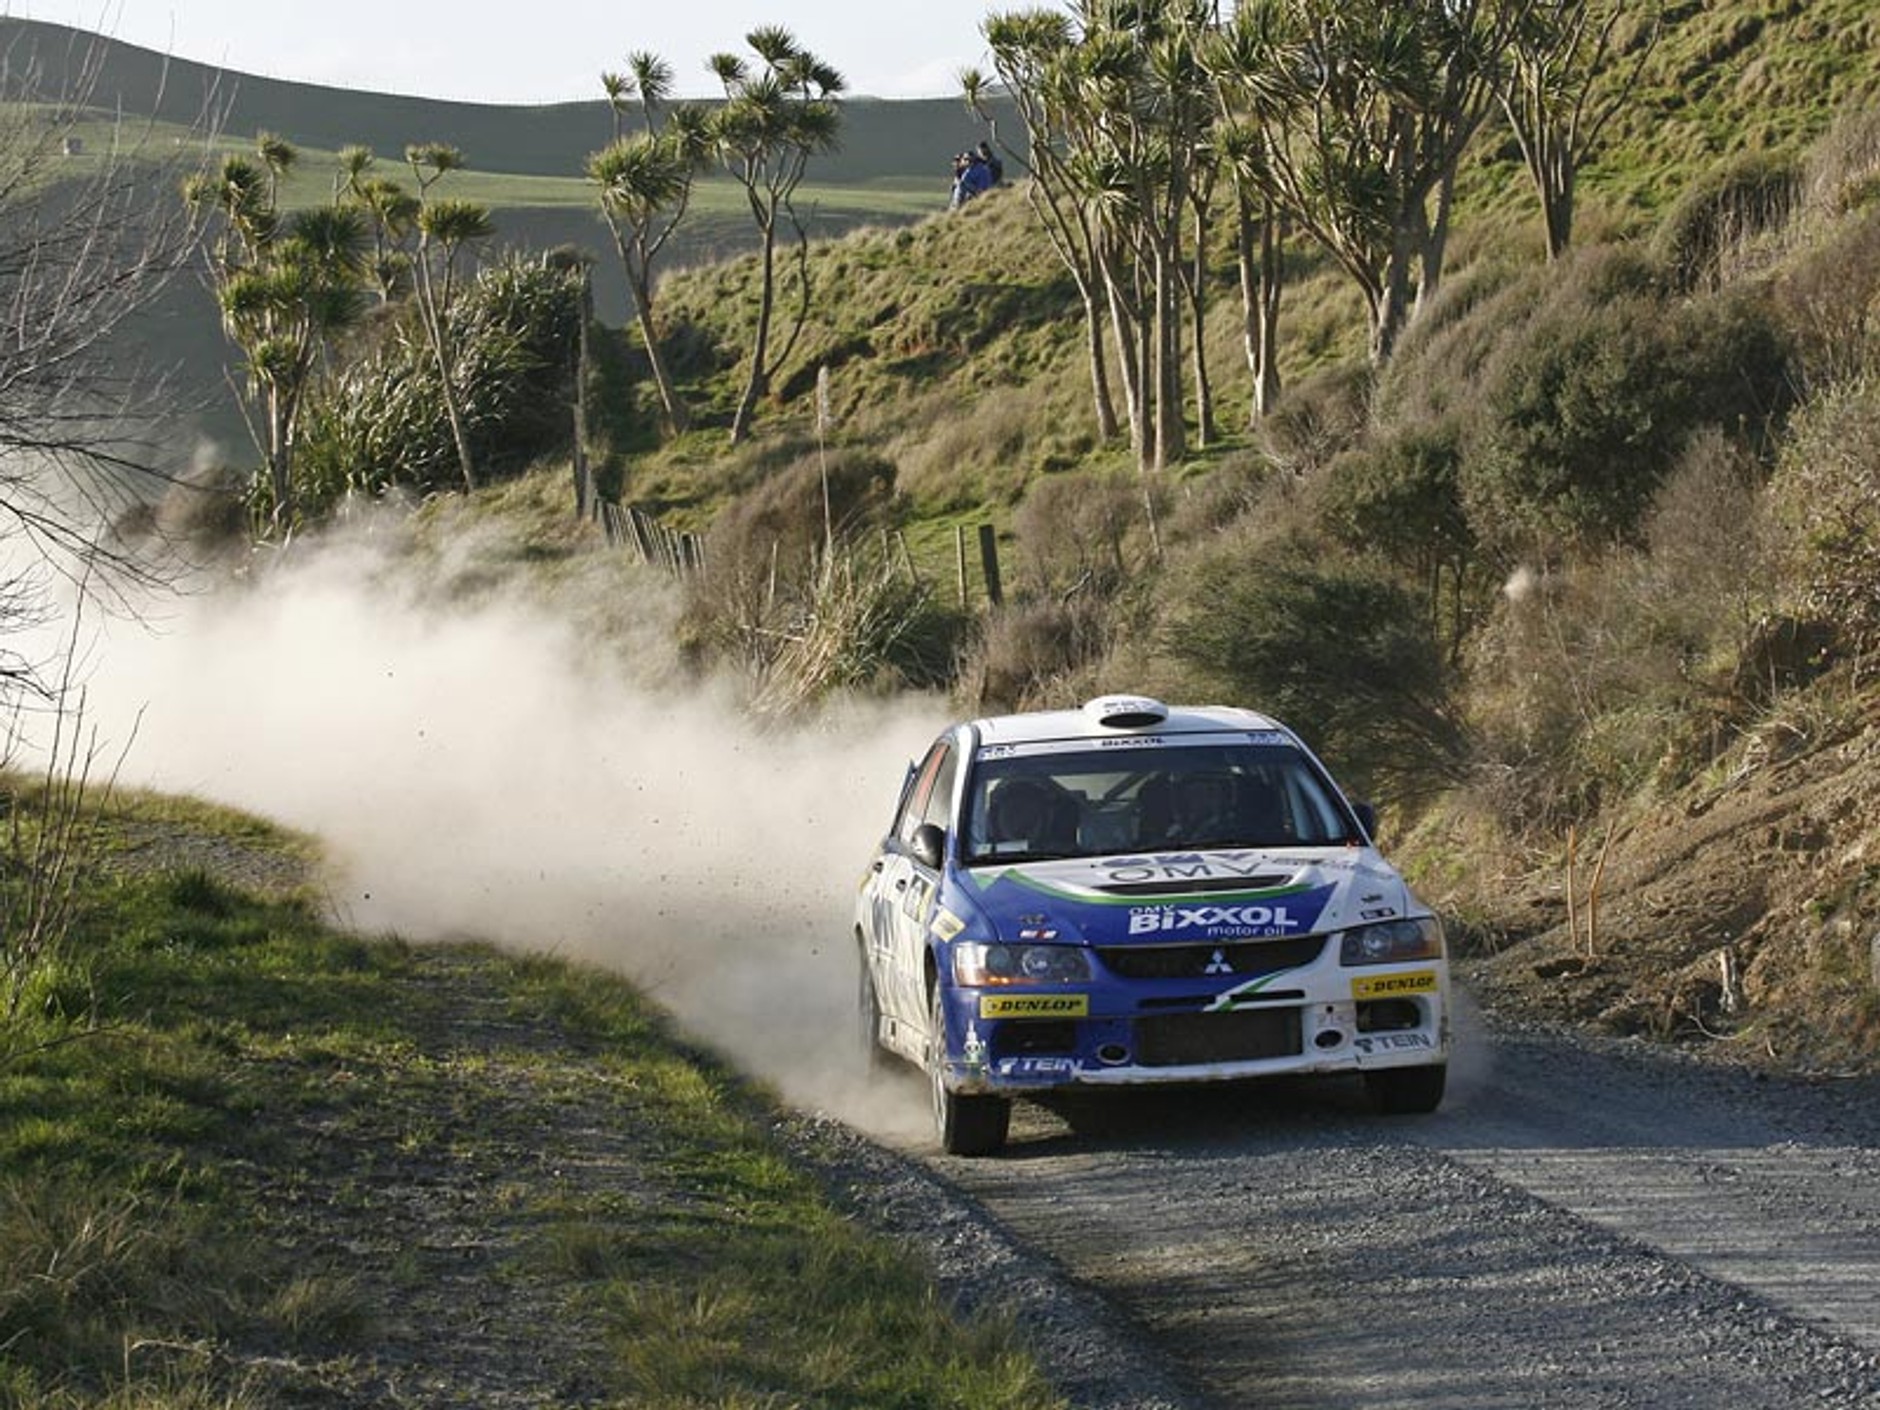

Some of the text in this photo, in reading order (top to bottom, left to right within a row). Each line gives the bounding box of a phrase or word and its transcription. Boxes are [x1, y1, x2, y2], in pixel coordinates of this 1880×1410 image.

[1109, 863, 1261, 882] OMV
[1129, 904, 1175, 915] OMV
[1208, 924, 1285, 936] motor oil
[1372, 977, 1434, 992] DUNLOP
[1000, 999, 1081, 1012] DUNLOP
[1375, 1034, 1431, 1049] TEIN
[1021, 1057, 1084, 1072] TEIN
